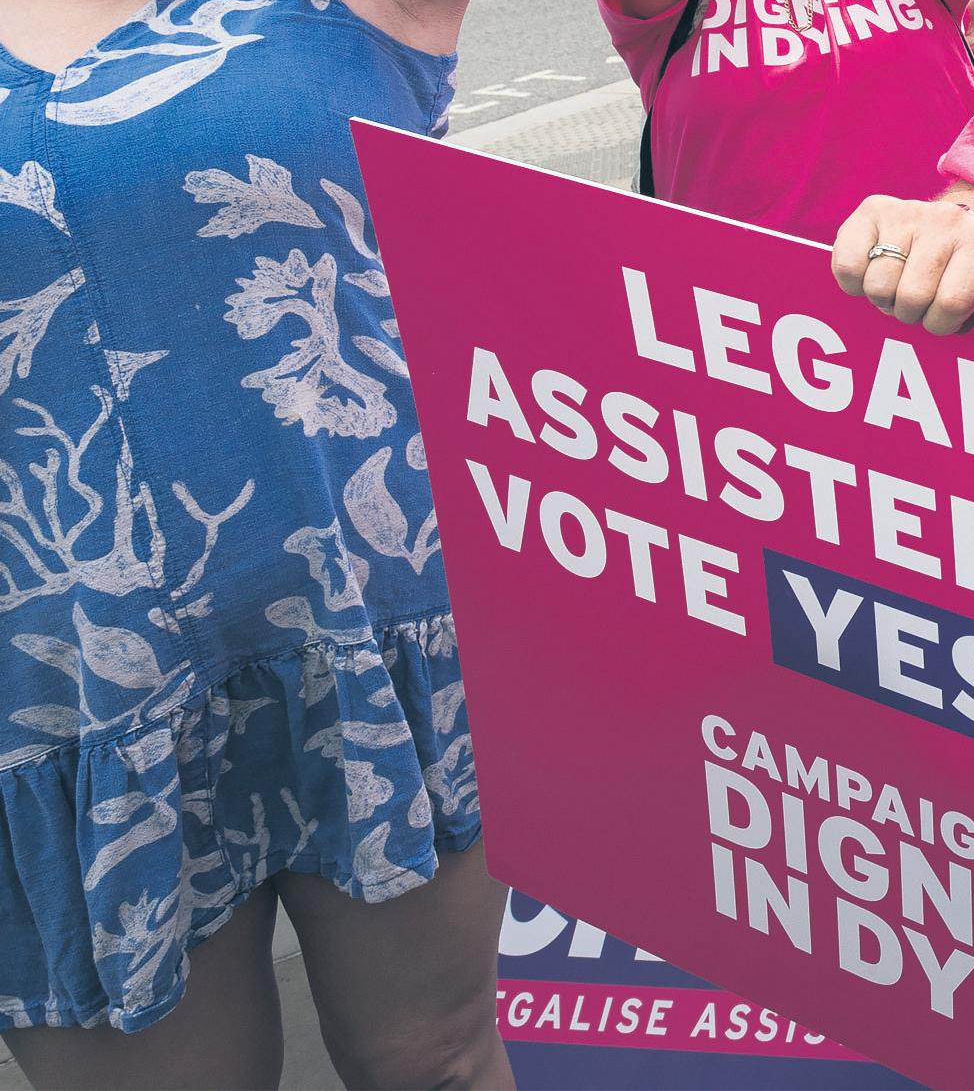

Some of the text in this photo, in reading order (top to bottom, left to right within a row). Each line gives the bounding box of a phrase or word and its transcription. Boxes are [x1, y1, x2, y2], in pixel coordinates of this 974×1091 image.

[691, 27, 749, 77] IN
[465, 458, 746, 637] VOTE
[711, 841, 813, 955] IN
